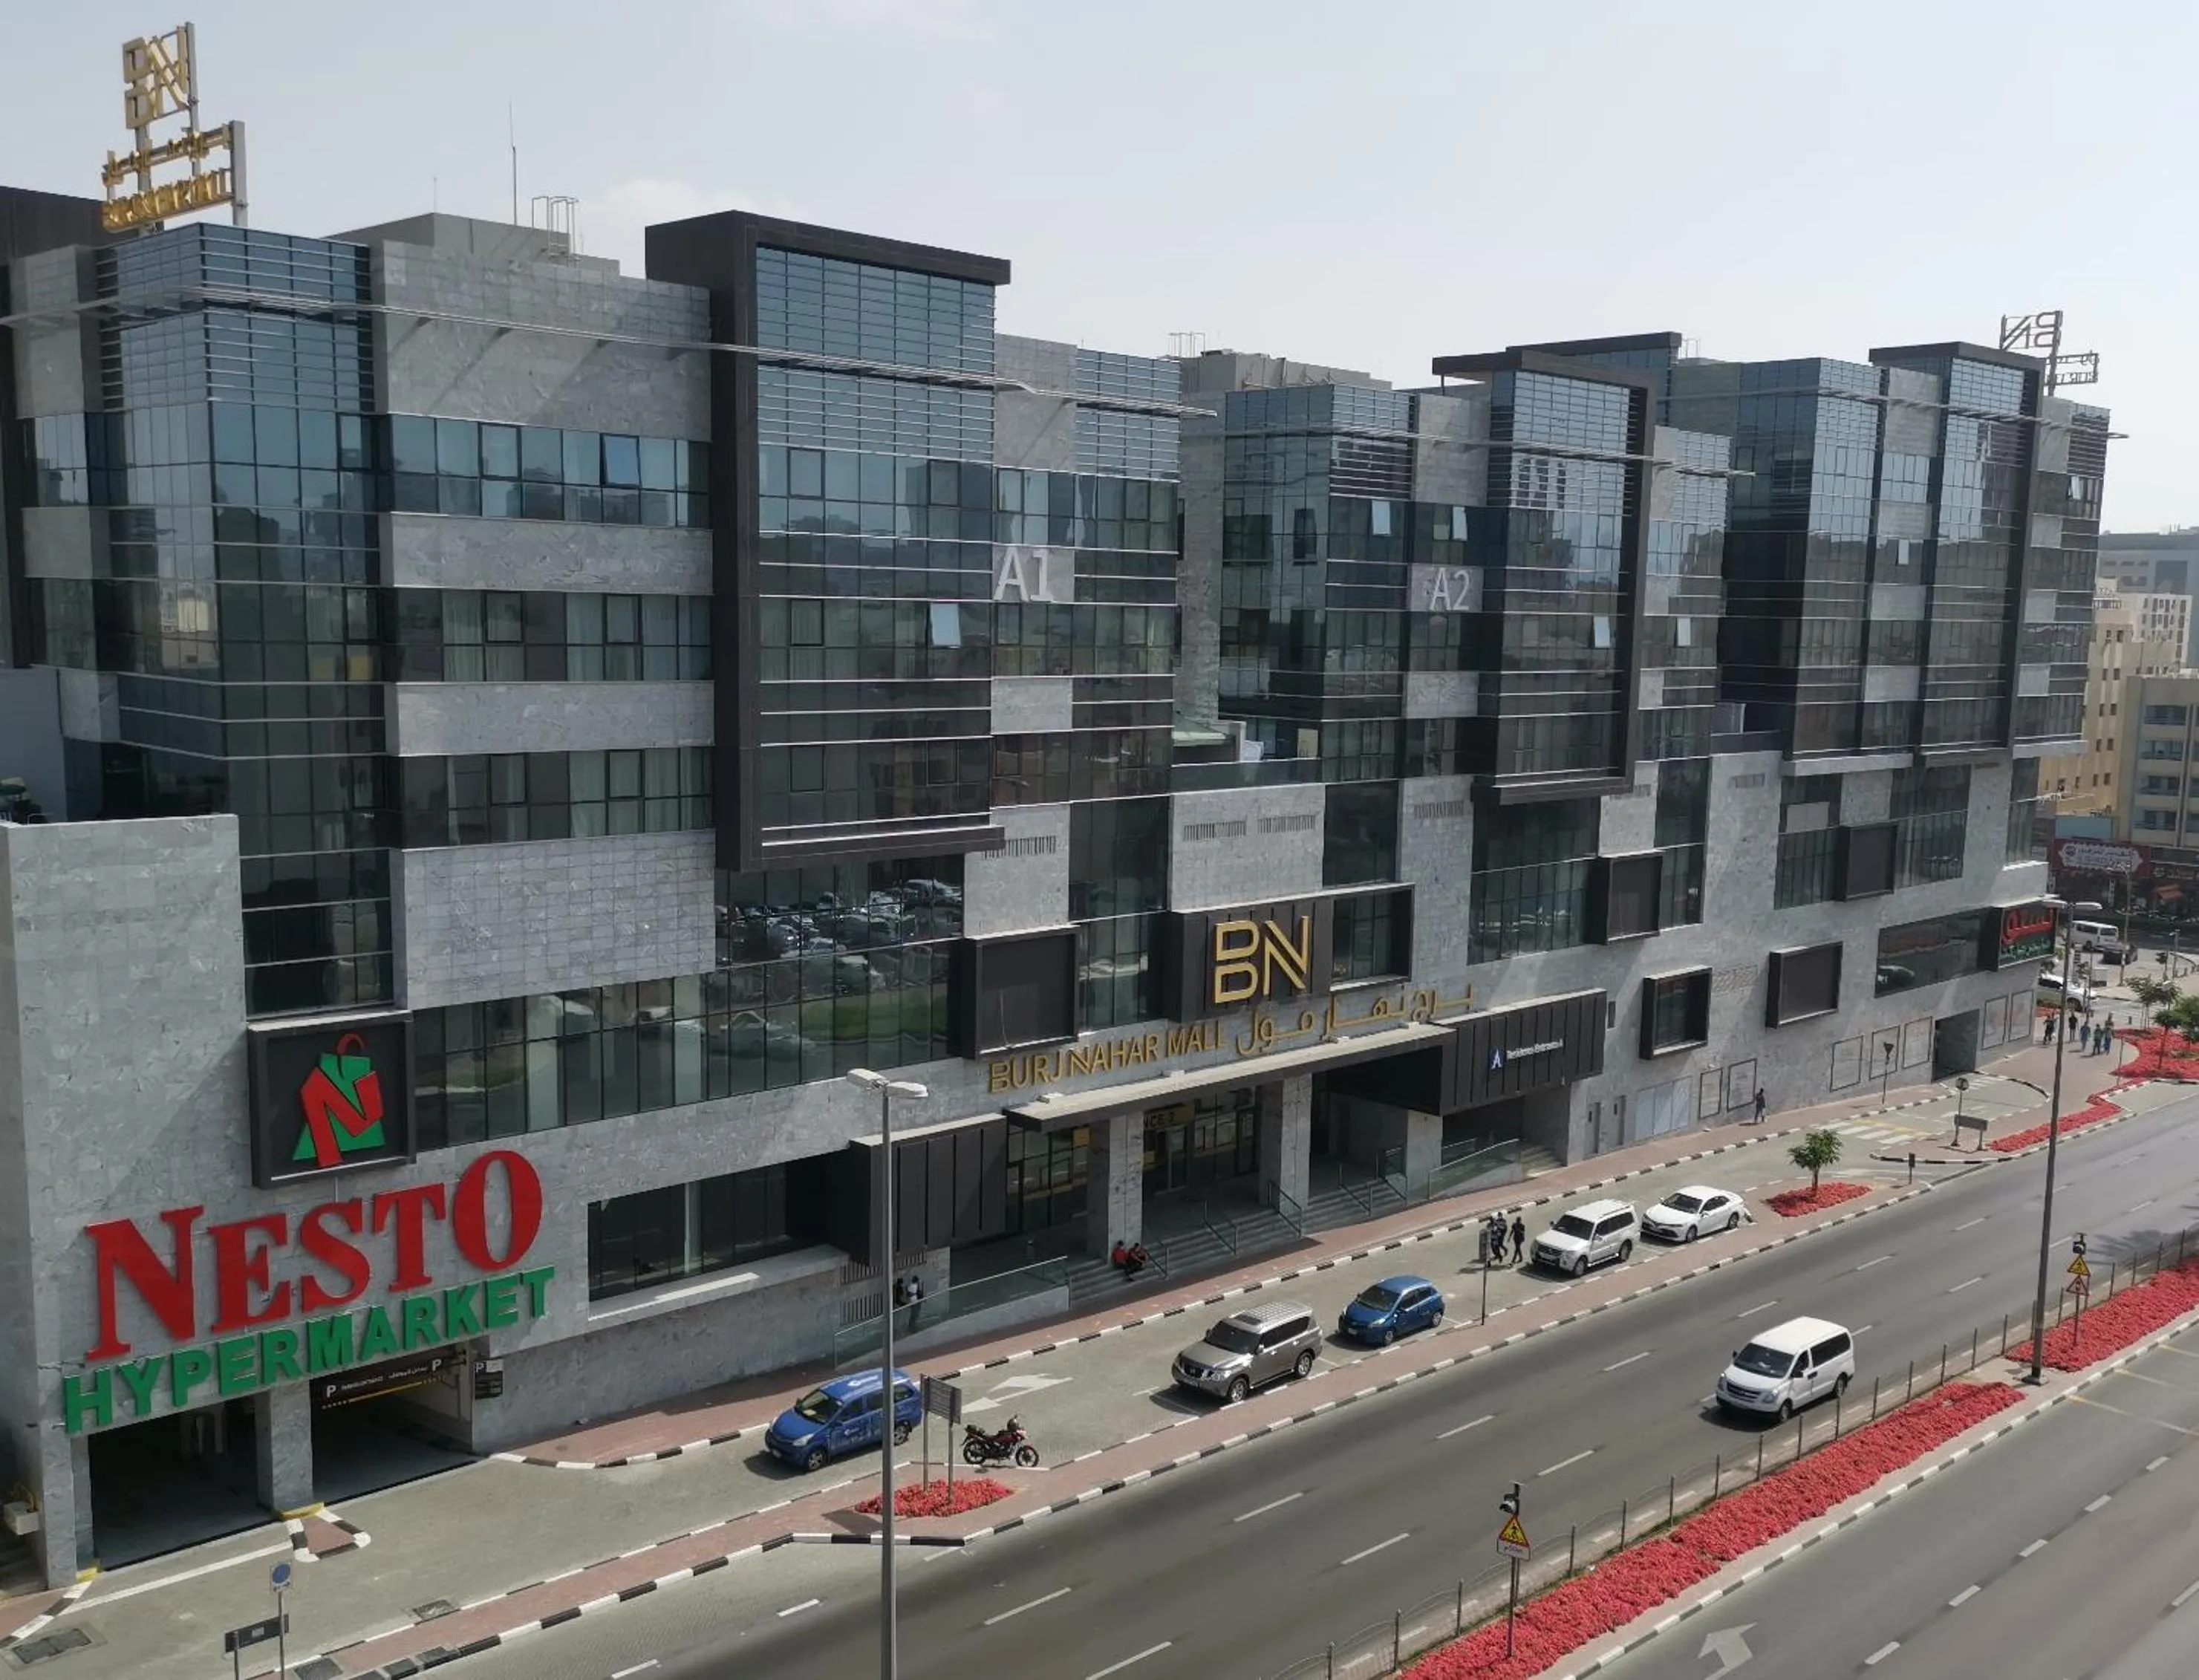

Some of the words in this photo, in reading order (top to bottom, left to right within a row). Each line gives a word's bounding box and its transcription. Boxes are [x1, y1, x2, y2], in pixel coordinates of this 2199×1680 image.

[994, 545, 1054, 602] A1
[1429, 567, 1470, 611] A2
[1214, 916, 1310, 1004] BN
[988, 1048, 1064, 1093] BURJ
[1066, 1032, 1160, 1075] NAHAR
[1165, 1020, 1226, 1058] MALL
[1236, 1001, 1315, 1056] مول
[84, 1149, 543, 1361] NESTO
[64, 1266, 556, 1435] HYPERMARKET
